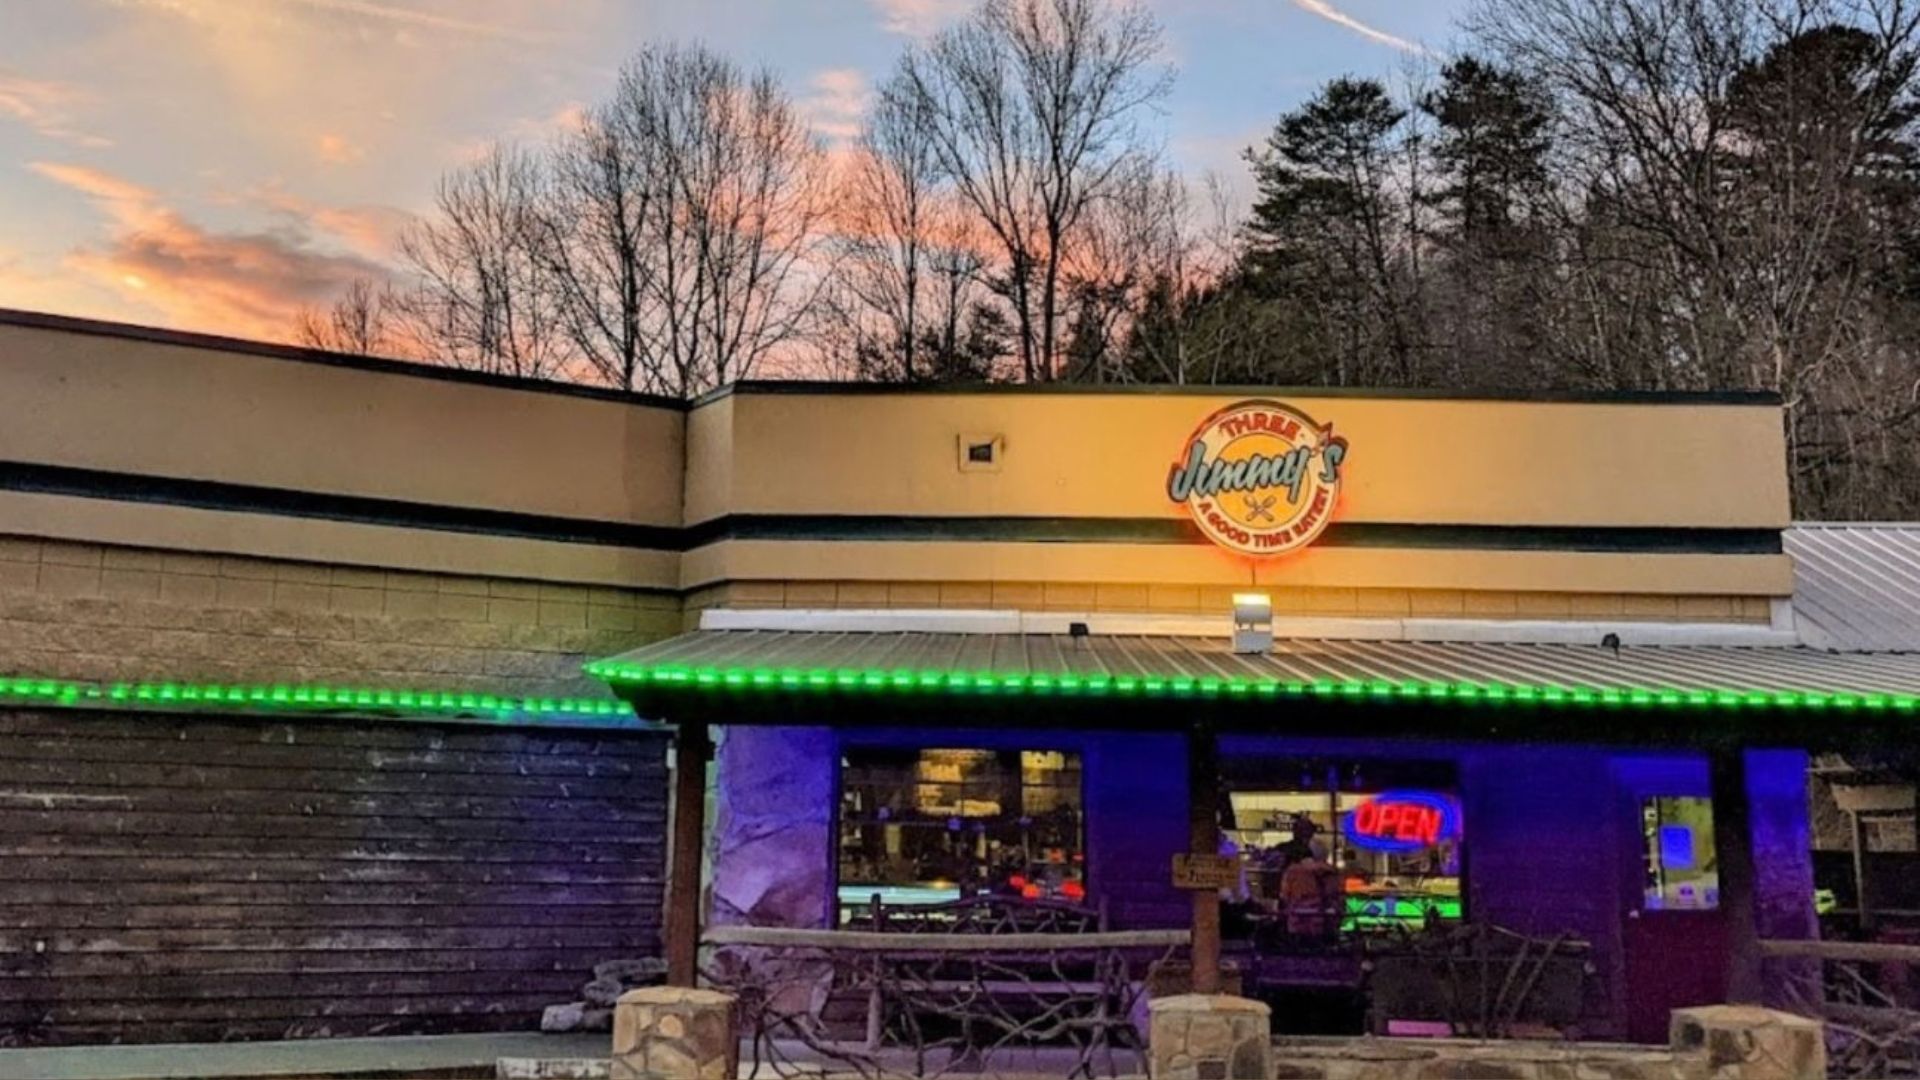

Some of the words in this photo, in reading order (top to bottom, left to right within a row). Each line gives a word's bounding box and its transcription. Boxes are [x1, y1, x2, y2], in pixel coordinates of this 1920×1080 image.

[1220, 412, 1302, 441] THREE
[1168, 435, 1348, 504] Jimmy's
[1198, 501, 1212, 515] A
[1207, 512, 1250, 545] GOOD
[1253, 529, 1292, 547] TIME
[1291, 485, 1329, 537] EATERY
[1354, 800, 1442, 845] OPEN
